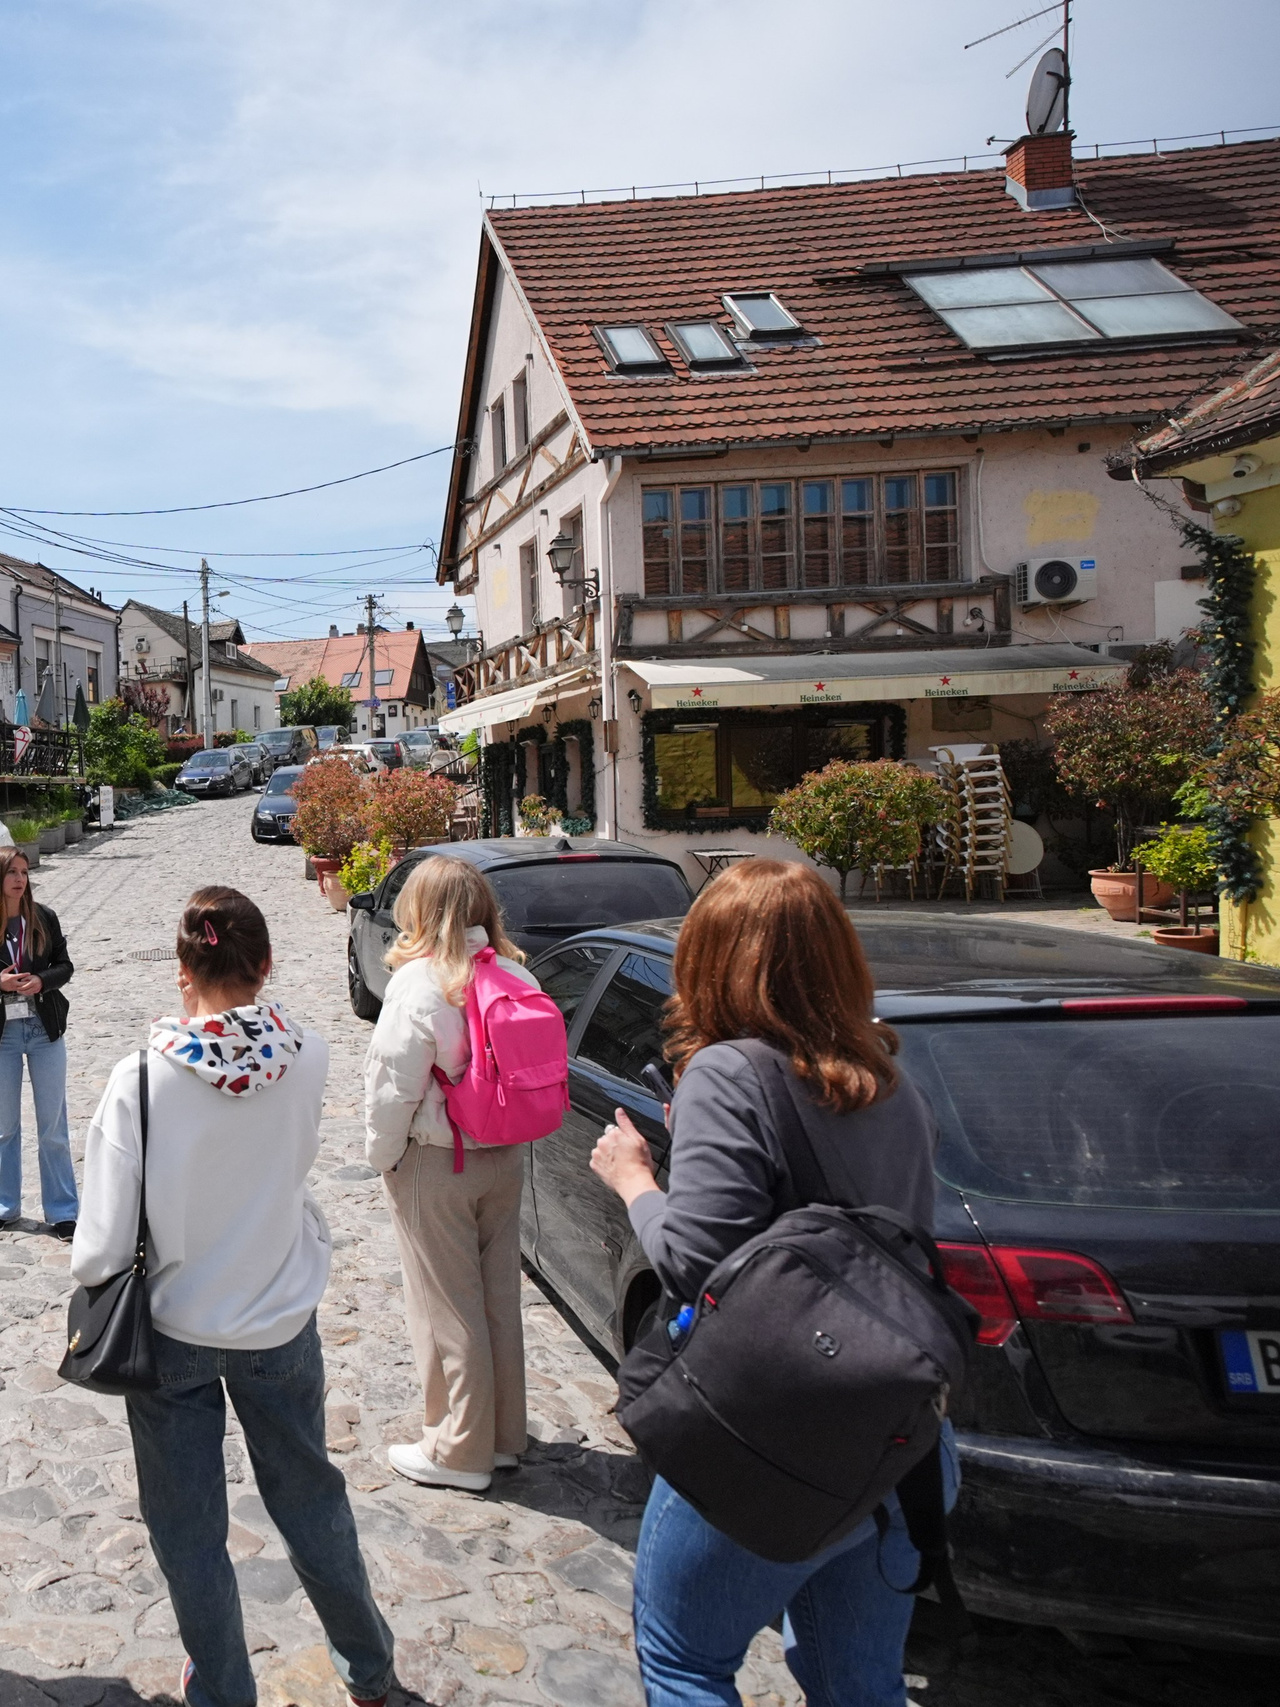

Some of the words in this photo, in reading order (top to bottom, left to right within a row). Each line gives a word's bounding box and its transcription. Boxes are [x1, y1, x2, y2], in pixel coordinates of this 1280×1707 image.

[448, 682, 455, 691] P
[1053, 682, 1098, 691] Heineken
[925, 688, 969, 697] Heineken
[799, 693, 842, 703] Heineken
[676, 698, 719, 708] Heineken
[1228, 1372, 1254, 1386] SRB
